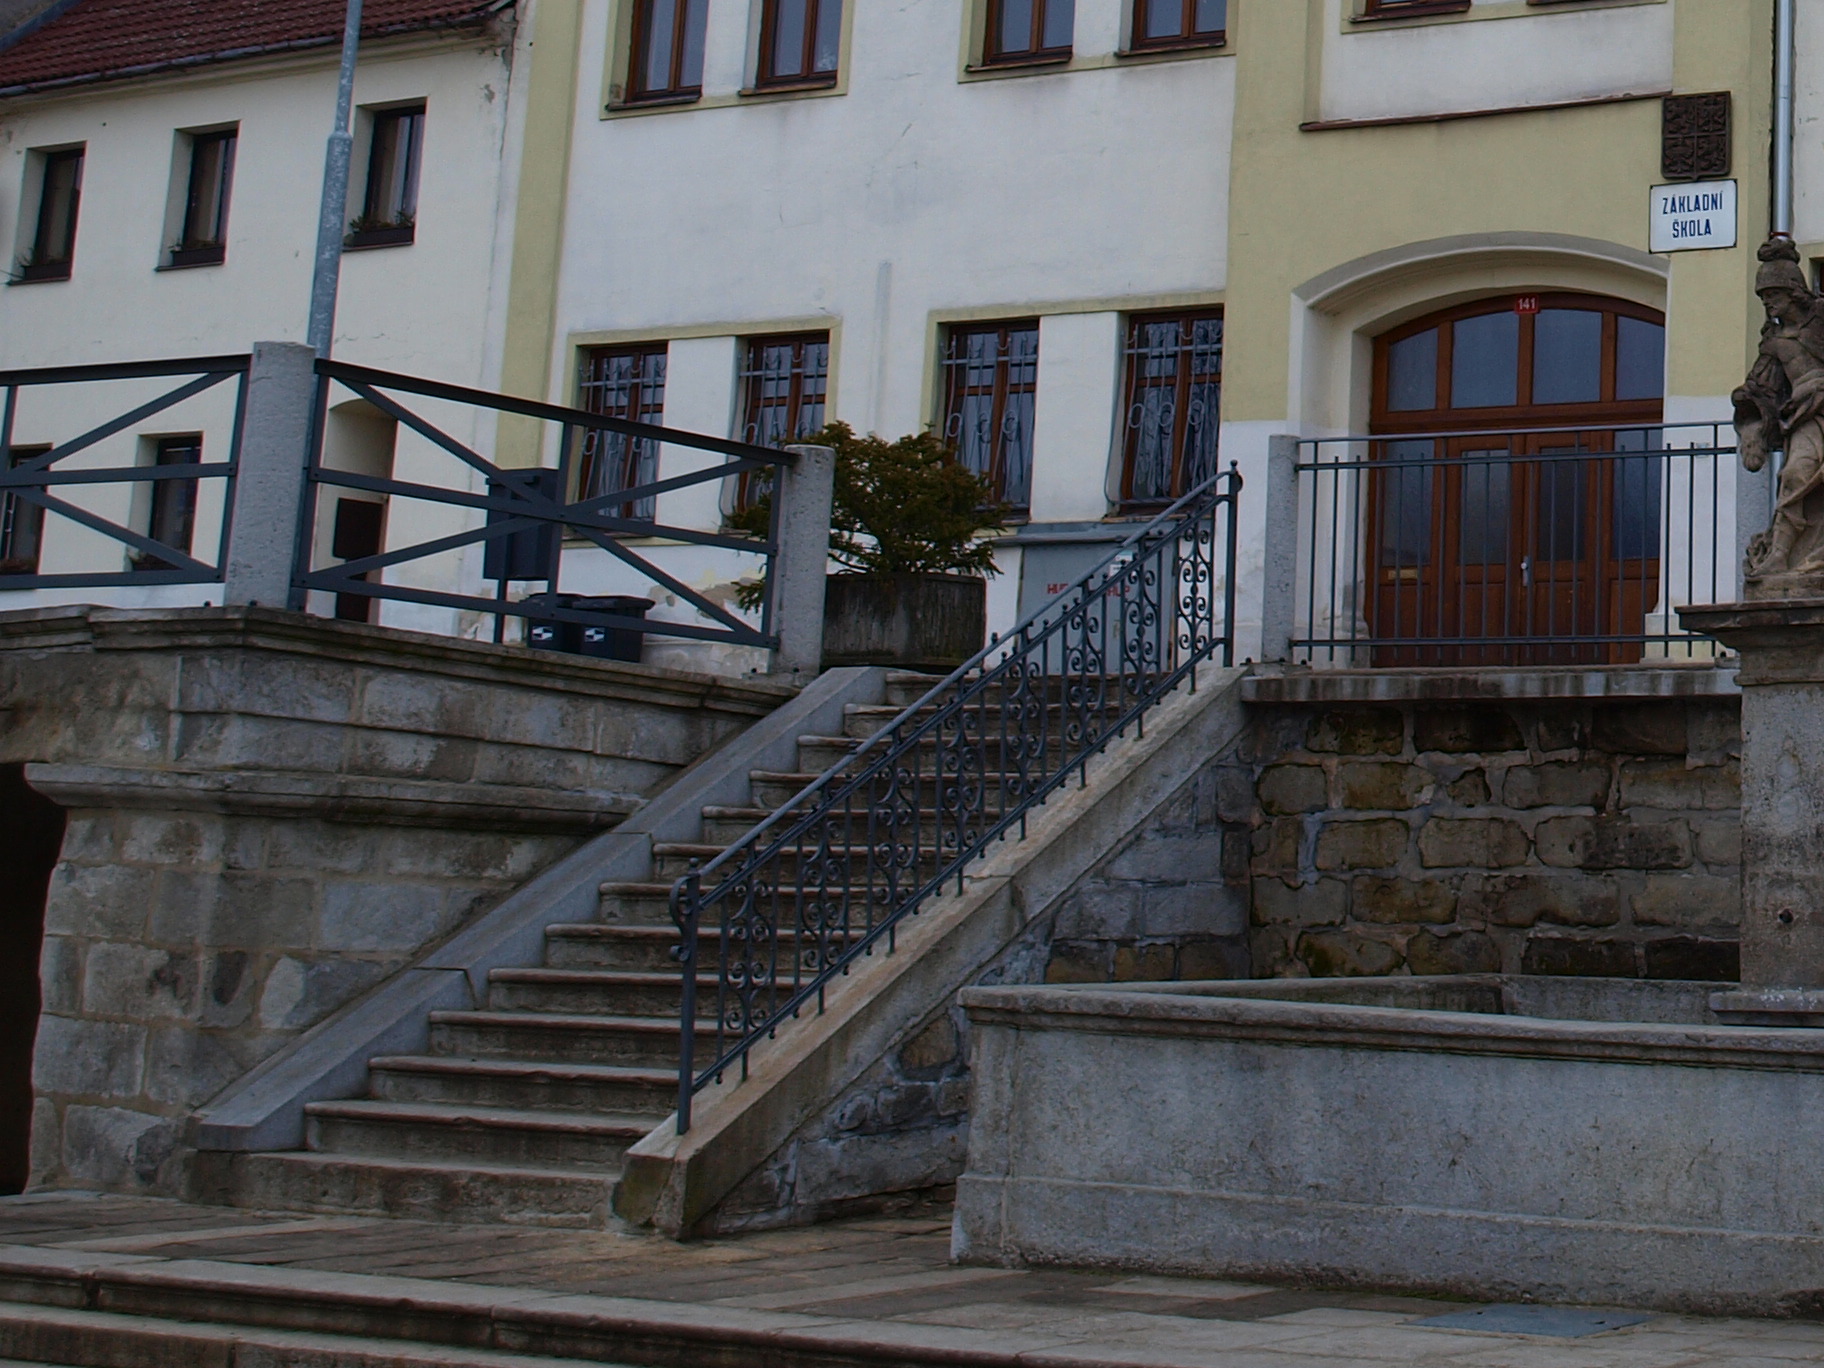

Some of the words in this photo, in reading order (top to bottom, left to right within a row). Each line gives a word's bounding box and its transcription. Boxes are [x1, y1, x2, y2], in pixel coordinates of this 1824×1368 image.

[1662, 190, 1723, 215] ZÁKLADNÍ
[1672, 218, 1712, 239] ŠKOLA
[1518, 297, 1536, 310] 141
